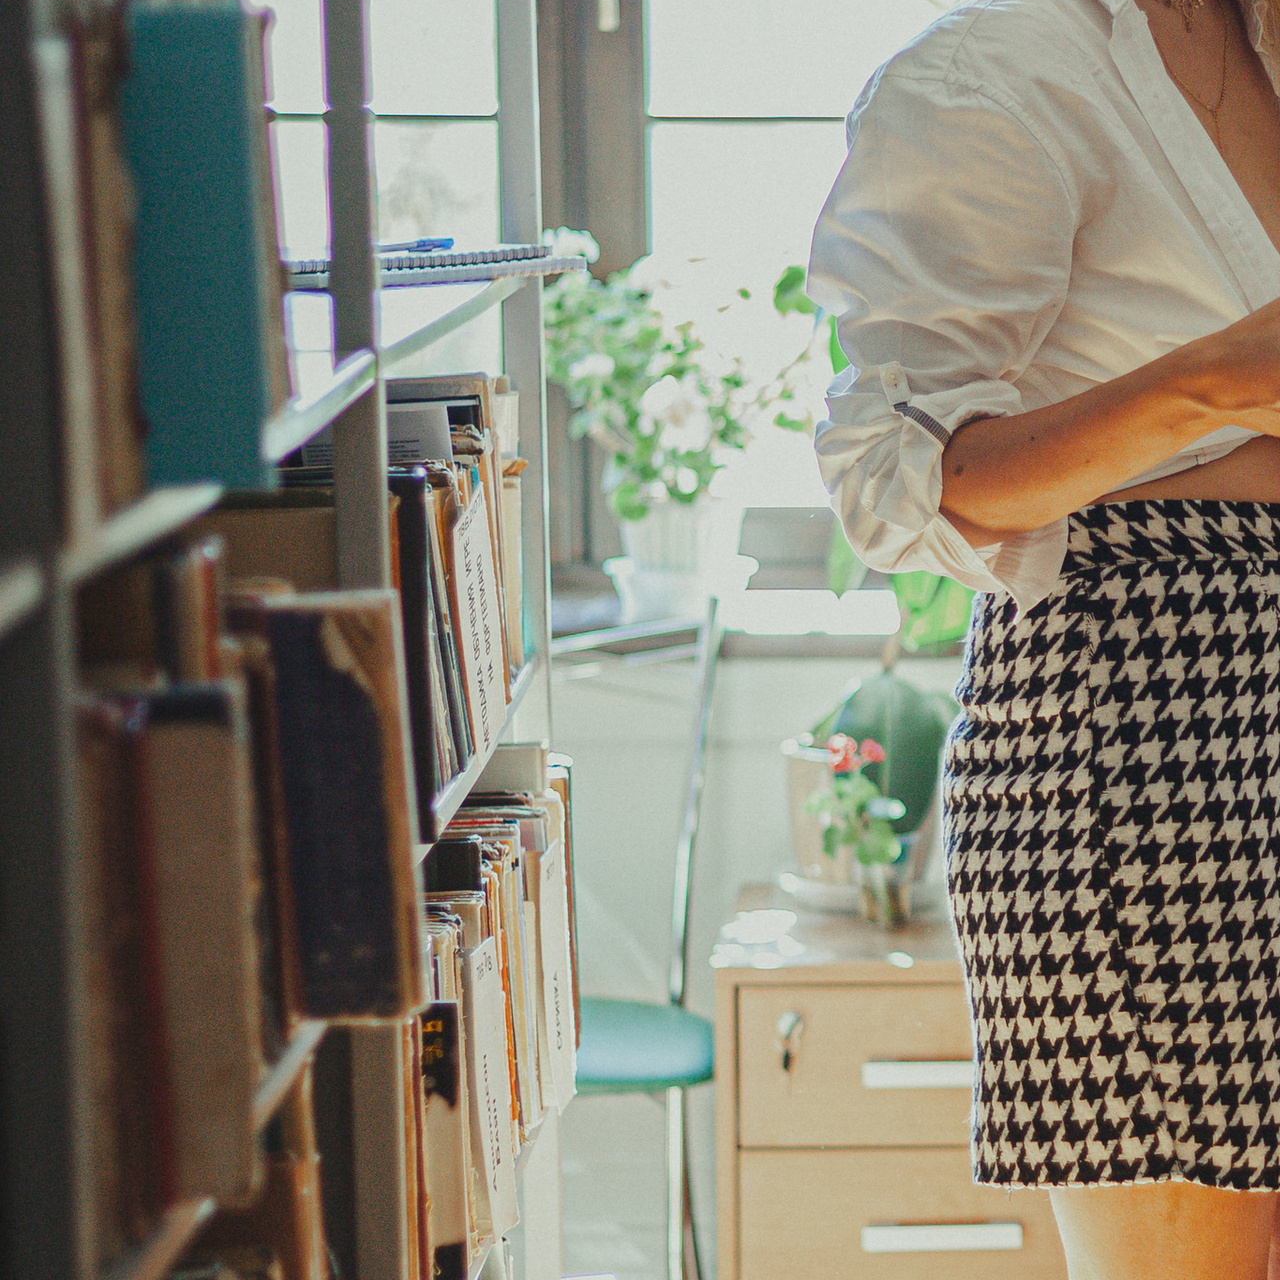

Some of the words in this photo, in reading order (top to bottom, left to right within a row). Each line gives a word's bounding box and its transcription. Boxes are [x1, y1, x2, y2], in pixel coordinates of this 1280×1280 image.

[463, 539, 473, 578] ИГРЕ
[466, 581, 482, 661] ОБУЧЕНИЯ
[475, 553, 491, 657] ФОРТЕПИАНО
[477, 665, 491, 752] МЕТОДИКА
[485, 660, 495, 685] НА
